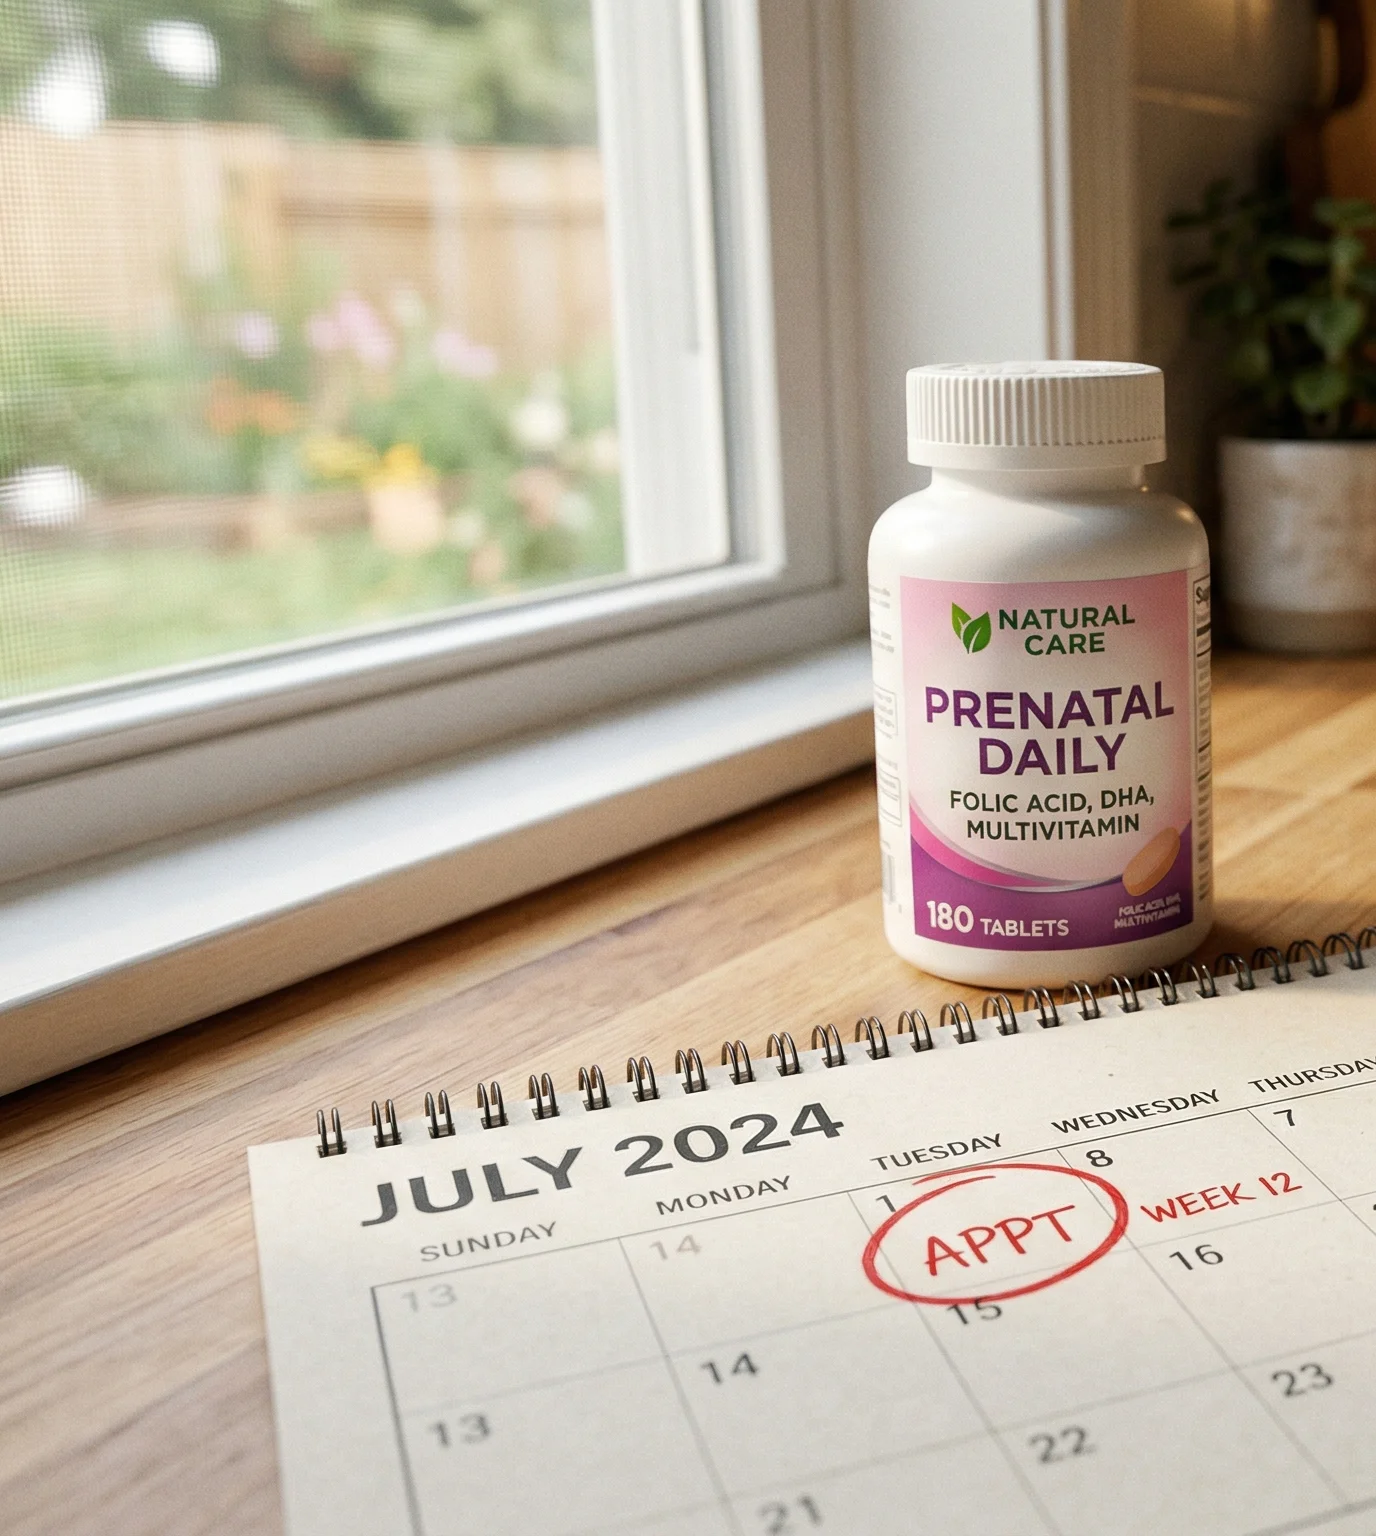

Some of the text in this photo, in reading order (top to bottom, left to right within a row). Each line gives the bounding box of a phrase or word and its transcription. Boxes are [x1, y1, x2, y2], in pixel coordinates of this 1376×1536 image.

[999, 604, 1135, 629] NATURAL
[1024, 632, 1105, 656] CARE
[925, 681, 1174, 729] PRENATAL
[979, 733, 1126, 776] DAILY
[950, 785, 1155, 814] FOLIC ACID, DHA,
[967, 814, 1140, 841] MULTIVITAMIN
[926, 901, 1069, 937] 180 TABLETS
[361, 1102, 845, 1228] JULY 2024
[420, 1220, 558, 1263] SUNDAY
[655, 1175, 792, 1216] MONDAY
[871, 1134, 1004, 1172] TUESDAY
[1051, 1089, 1221, 1135] WEDNESDAY
[401, 1284, 458, 1313] 13
[651, 1234, 702, 1261] 14
[876, 1194, 896, 1212] 1
[1086, 1150, 1113, 1168] 8
[1273, 1109, 1297, 1128] 7
[924, 1171, 1303, 1276] APPT WEEK 12
[427, 1414, 493, 1449] 13
[701, 1353, 759, 1386] 14
[945, 1297, 1003, 1326] 15
[1169, 1244, 1224, 1272] 16
[758, 1493, 823, 1536] 21
[1027, 1427, 1095, 1464] 22
[1271, 1364, 1335, 1397] 23
